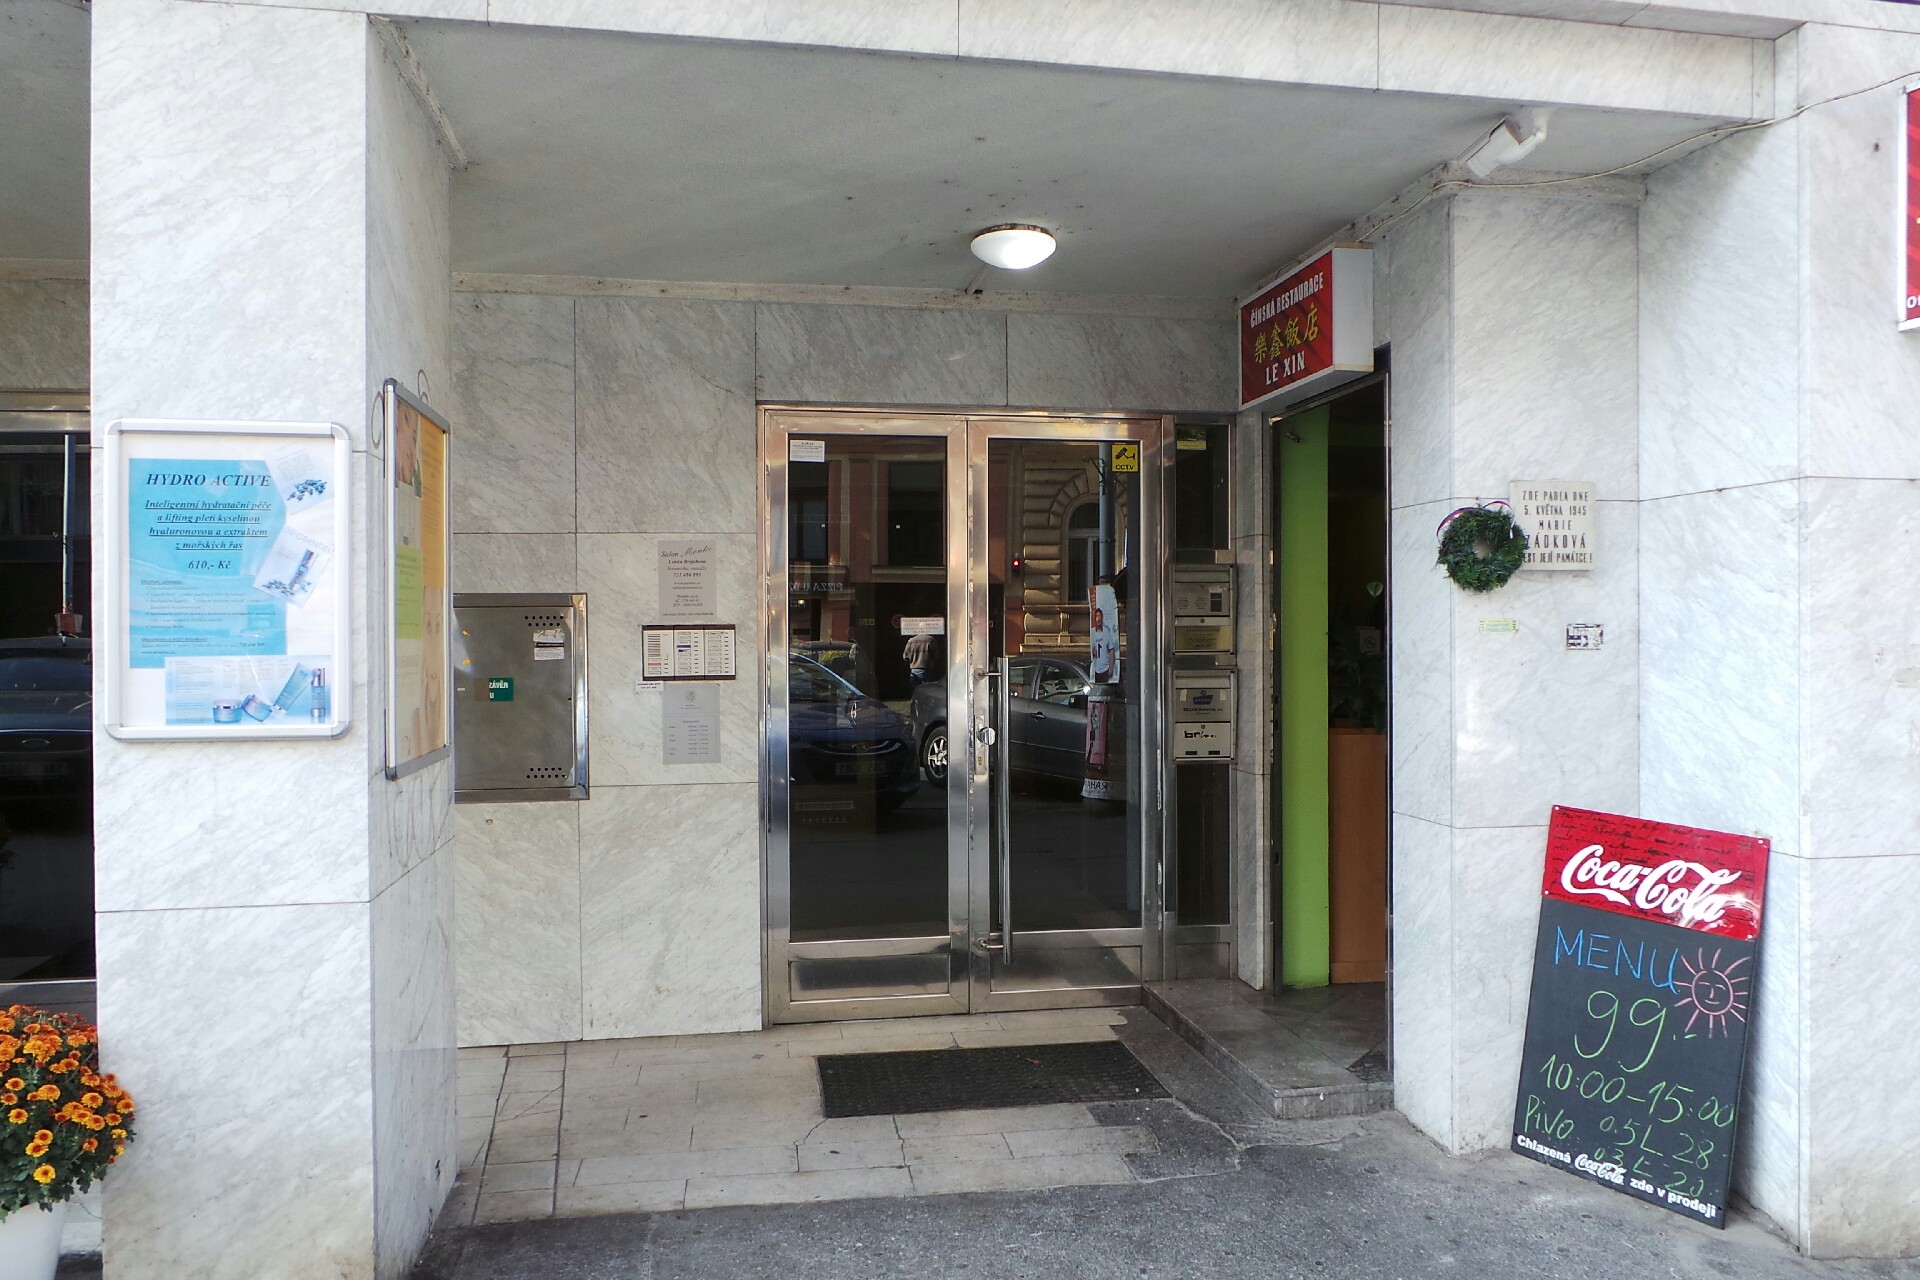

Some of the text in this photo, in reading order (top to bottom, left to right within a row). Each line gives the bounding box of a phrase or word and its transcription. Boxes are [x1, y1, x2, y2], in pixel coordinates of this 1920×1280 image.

[1250, 271, 1324, 328] ČÍNSKÁ RESTAURACE
[1265, 350, 1306, 386] LE XIN
[146, 473, 272, 487] HYDRO ACTIVE
[1522, 490, 1589, 501] ZDE PADLA DNE
[201, 500, 250, 510] hydratační
[1536, 503, 1563, 516] KVĚTNA
[1569, 505, 1587, 516] 1945
[165, 513, 193, 523] lifting
[217, 514, 260, 523] kyselinou
[1538, 519, 1572, 530] MARIE
[224, 528, 268, 536] extraktem
[1523, 552, 1536, 563] EST
[1540, 550, 1553, 563] JEJÍ
[218, 560, 231, 569] Kč
[1560, 844, 1742, 922] Coca-Cola
[1554, 925, 1680, 995] MENU
[1517, 1134, 1571, 1164] Chlazená
[1629, 1177, 1655, 1194] zde
[1656, 1187, 1666, 1198] v
[1668, 1191, 1717, 1218] prodeji
